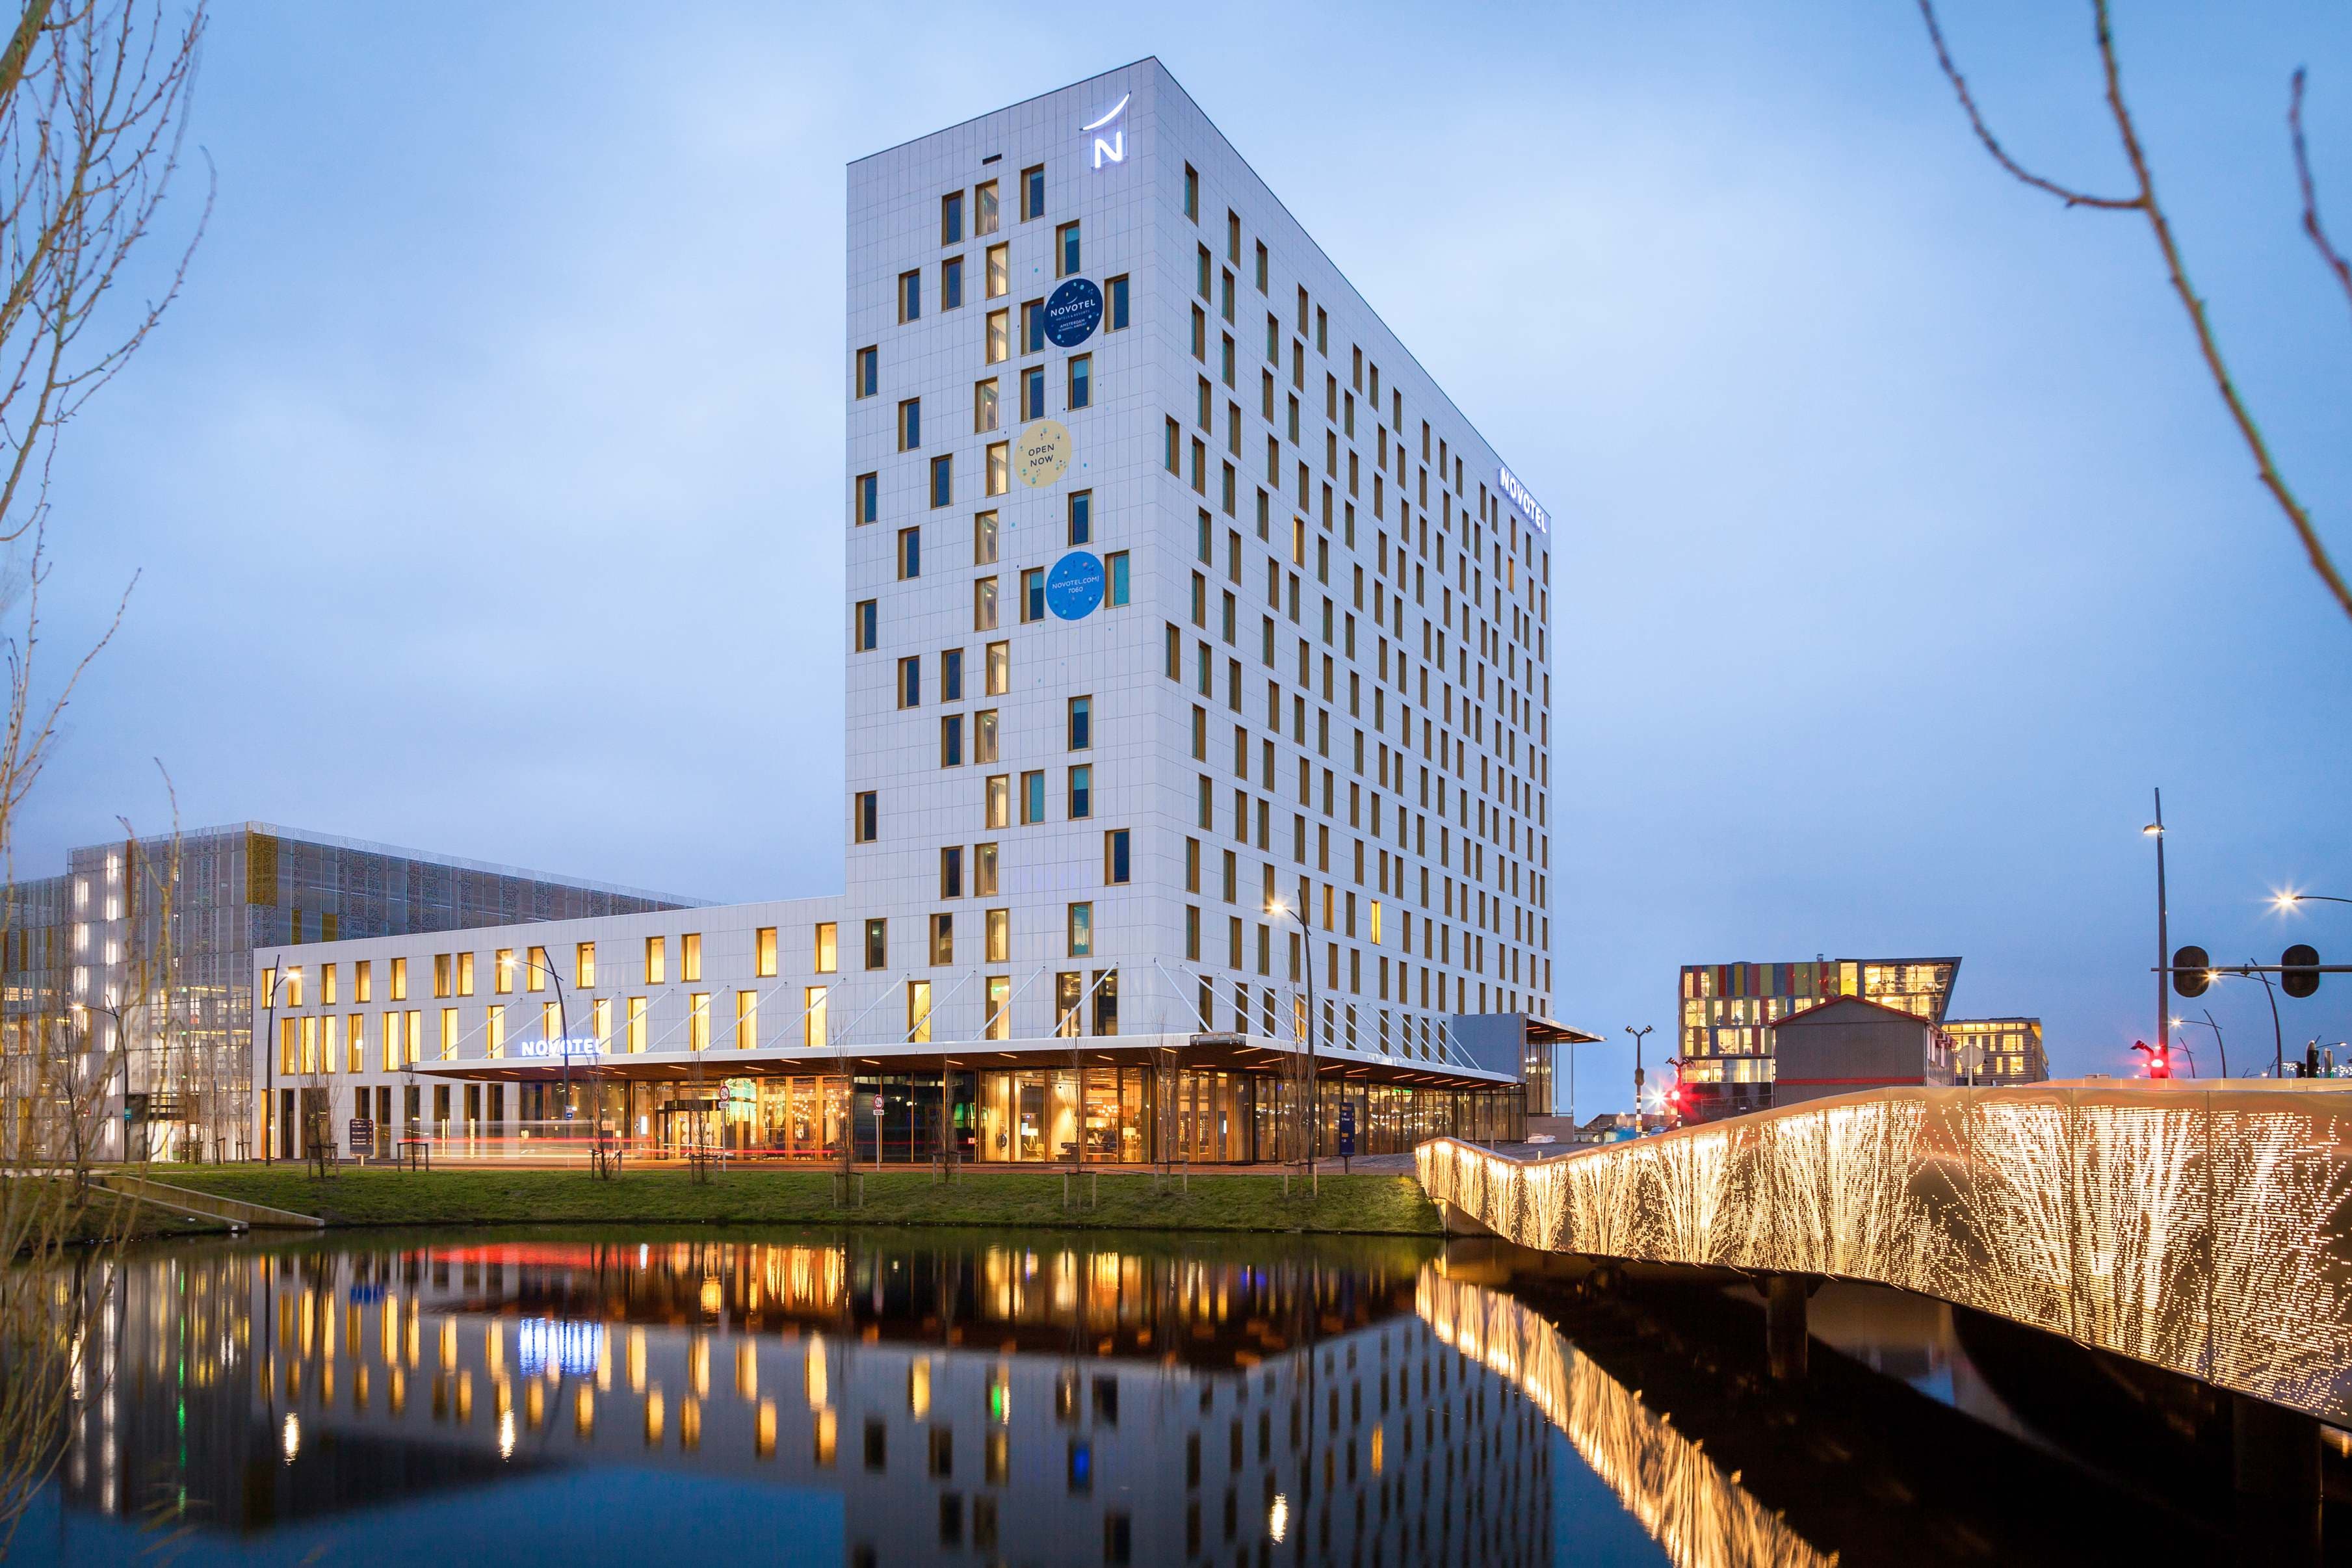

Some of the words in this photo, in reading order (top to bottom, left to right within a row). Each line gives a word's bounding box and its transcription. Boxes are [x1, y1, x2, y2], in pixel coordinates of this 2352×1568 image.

[1095, 131, 1123, 168] N
[1051, 299, 1095, 317] NOVOTEL
[1028, 443, 1054, 456] OPEN
[1030, 454, 1053, 467] NOW
[1500, 467, 1547, 533] NOVOTEL
[521, 1038, 604, 1056] NOVOTEL
